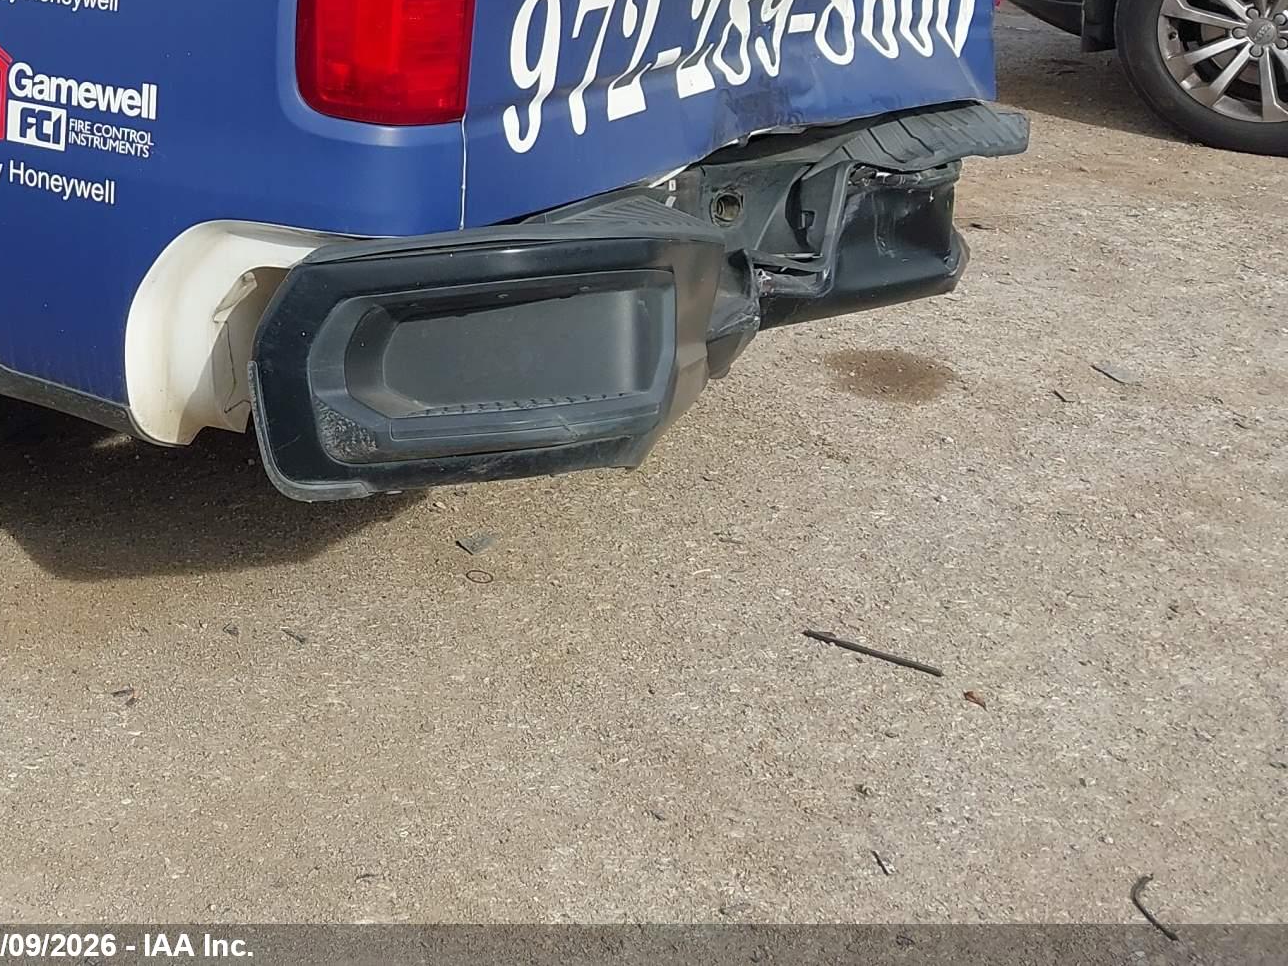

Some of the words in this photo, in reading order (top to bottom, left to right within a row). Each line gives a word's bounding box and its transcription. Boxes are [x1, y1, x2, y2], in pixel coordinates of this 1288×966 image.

[9, 62, 157, 120] Gamewell
[69, 118, 91, 134] FIRE
[93, 123, 154, 145] CONTROL
[69, 131, 149, 158] INSTRUMENTS
[9, 160, 115, 204] Honeywell
